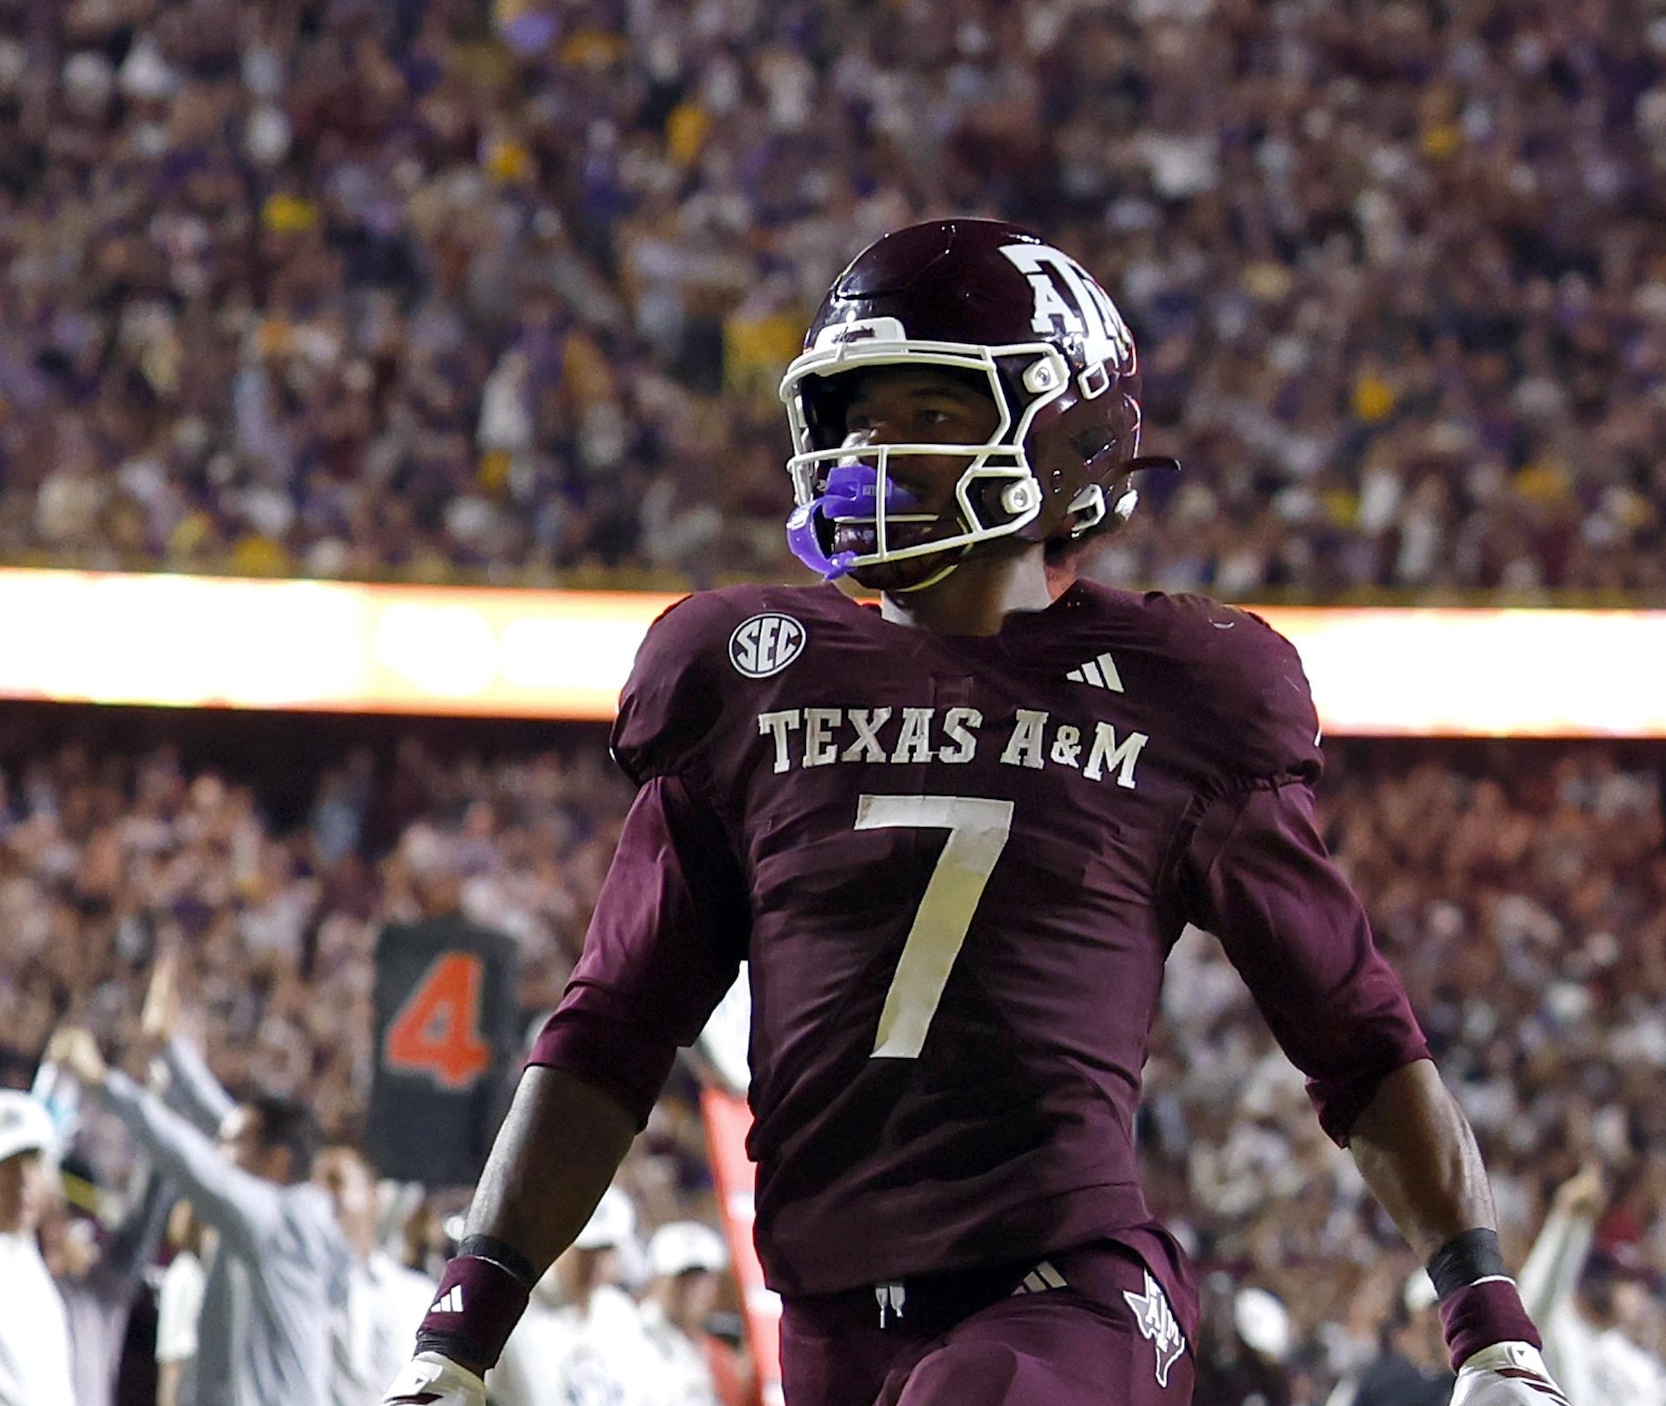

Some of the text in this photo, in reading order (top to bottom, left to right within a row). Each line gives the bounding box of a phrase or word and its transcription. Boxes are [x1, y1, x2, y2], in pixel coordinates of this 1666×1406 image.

[735, 617, 800, 672] SEC
[757, 705, 1150, 790] TEXAS A&M
[853, 793, 1016, 1060] 7
[385, 952, 493, 1090] 4
